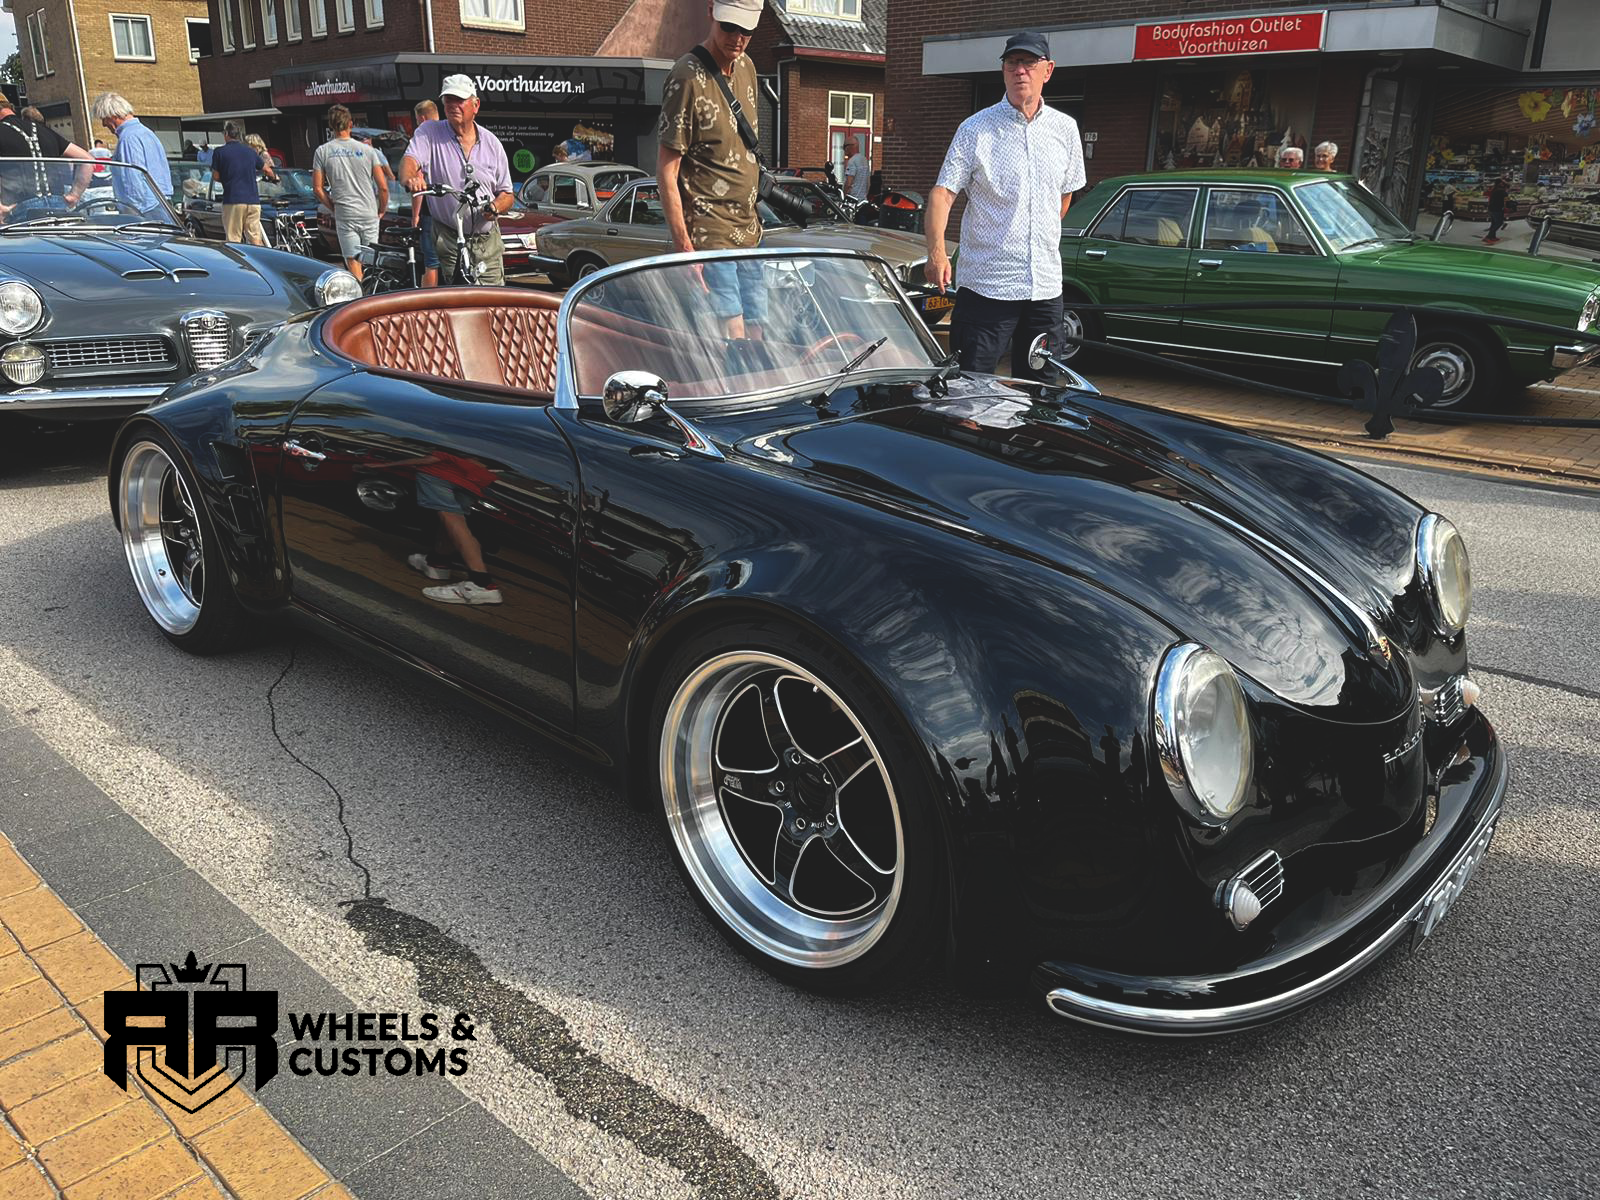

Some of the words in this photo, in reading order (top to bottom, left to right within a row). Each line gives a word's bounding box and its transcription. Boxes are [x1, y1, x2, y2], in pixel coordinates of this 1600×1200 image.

[1152, 22, 1244, 41] Bodyfashion
[1249, 17, 1302, 34] Outlet
[1178, 38, 1268, 55] Voorthuizen
